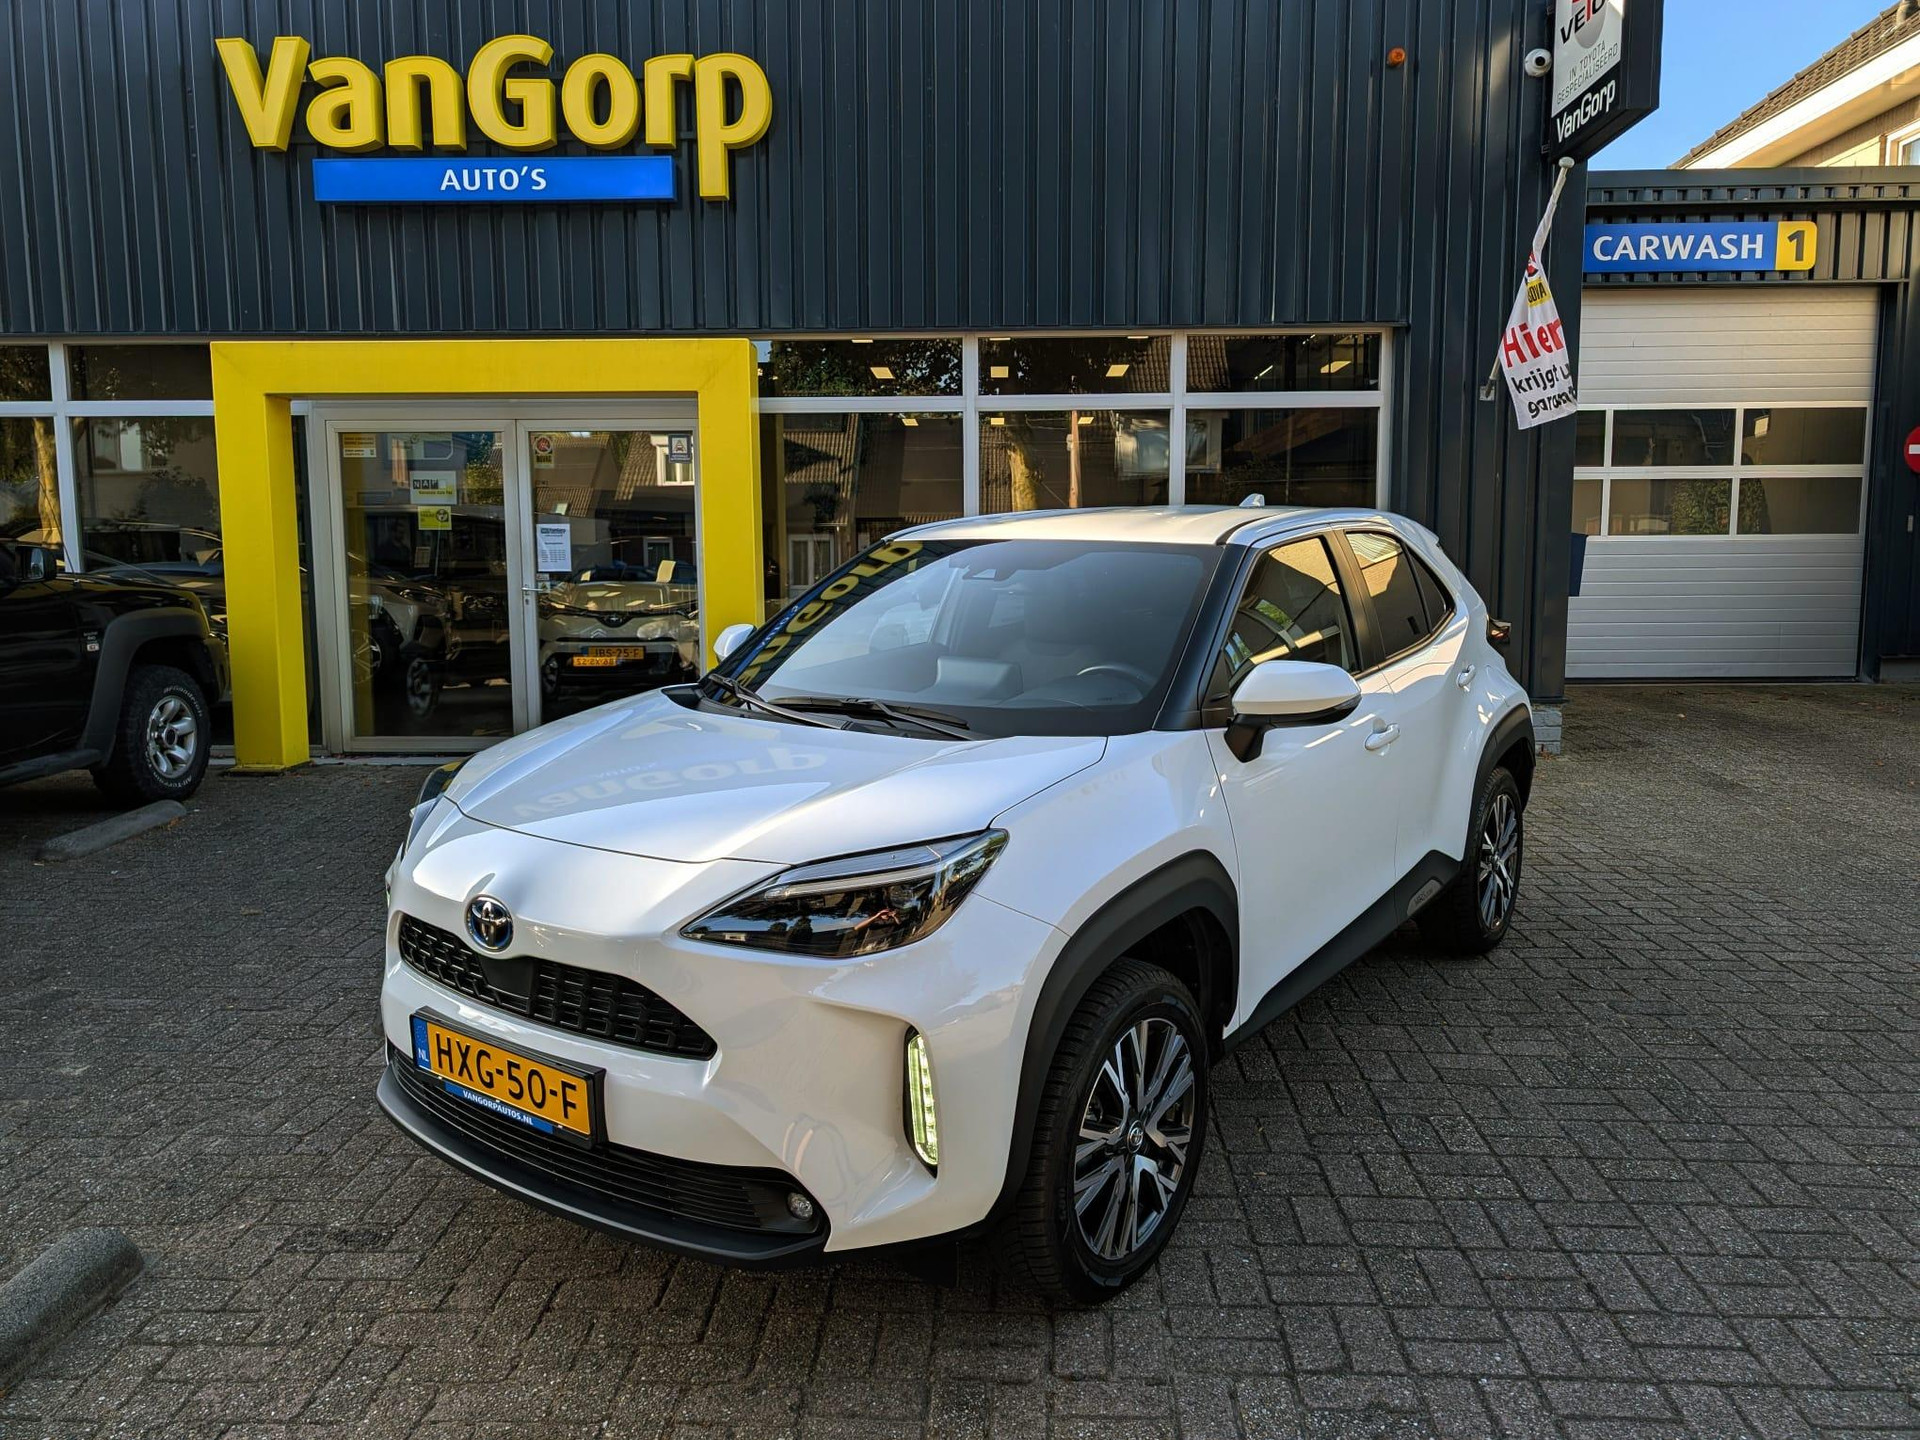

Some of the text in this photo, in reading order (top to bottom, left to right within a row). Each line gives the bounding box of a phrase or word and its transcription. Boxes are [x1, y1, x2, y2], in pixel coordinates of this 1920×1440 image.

[1569, 40, 1606, 82] IN TOYOTA
[215, 34, 772, 200] VanGorp
[1557, 80, 1616, 143] VanGorp
[440, 166, 547, 192] AUTO'S
[1593, 230, 1805, 262] CARWASH 1
[1503, 318, 1564, 368] Hier
[1511, 364, 1559, 394] krijgt
[418, 1048, 430, 1062] NL
[436, 1033, 577, 1119] HXG-50-F
[463, 1090, 534, 1126] VANGORPAUTOS.NL
